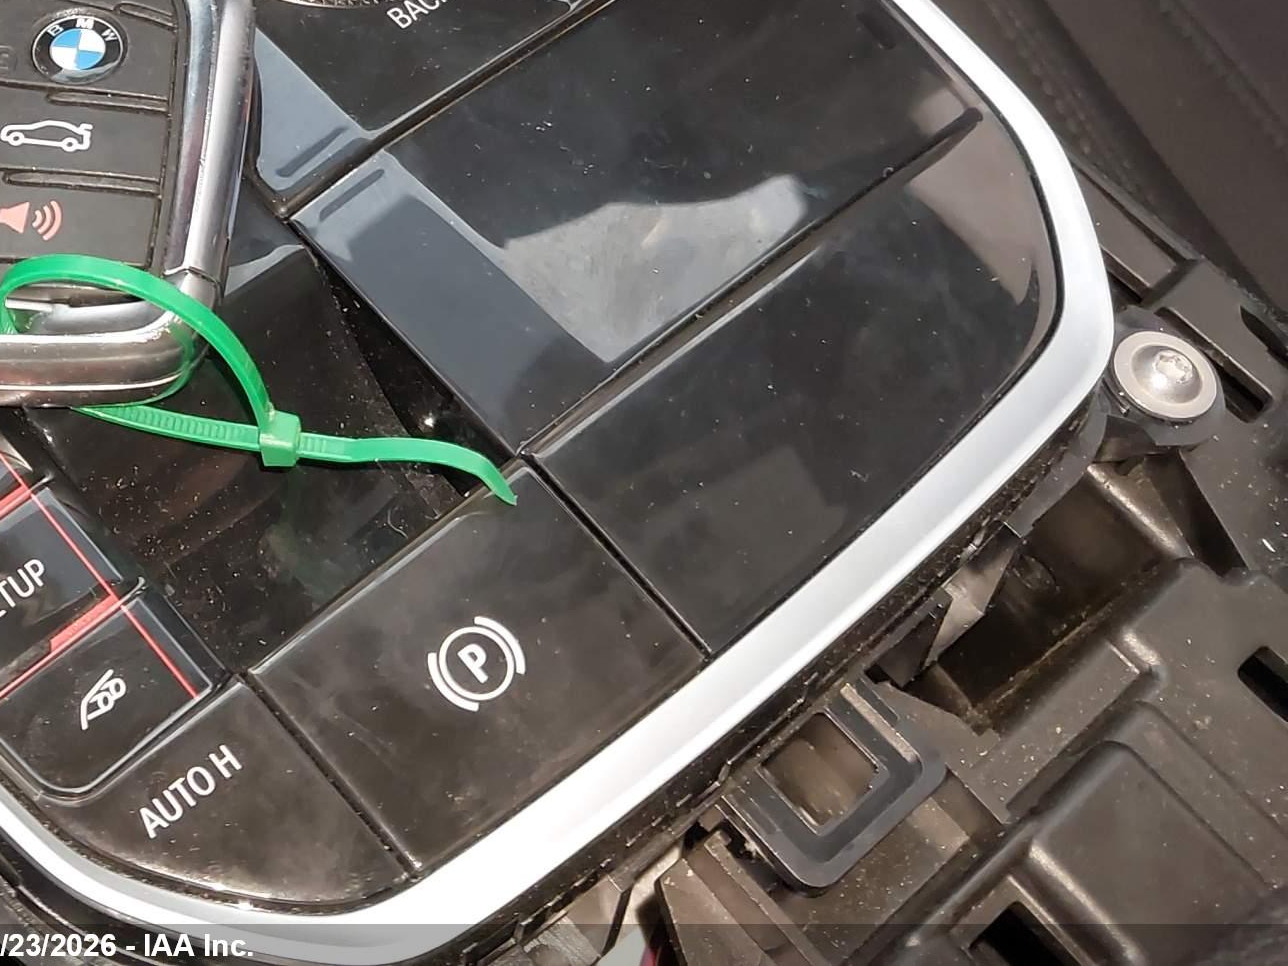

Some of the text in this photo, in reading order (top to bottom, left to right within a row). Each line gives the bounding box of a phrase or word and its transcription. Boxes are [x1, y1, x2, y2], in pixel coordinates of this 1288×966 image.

[47, 17, 117, 42] BMW
[138, 744, 242, 840] AUTO H
